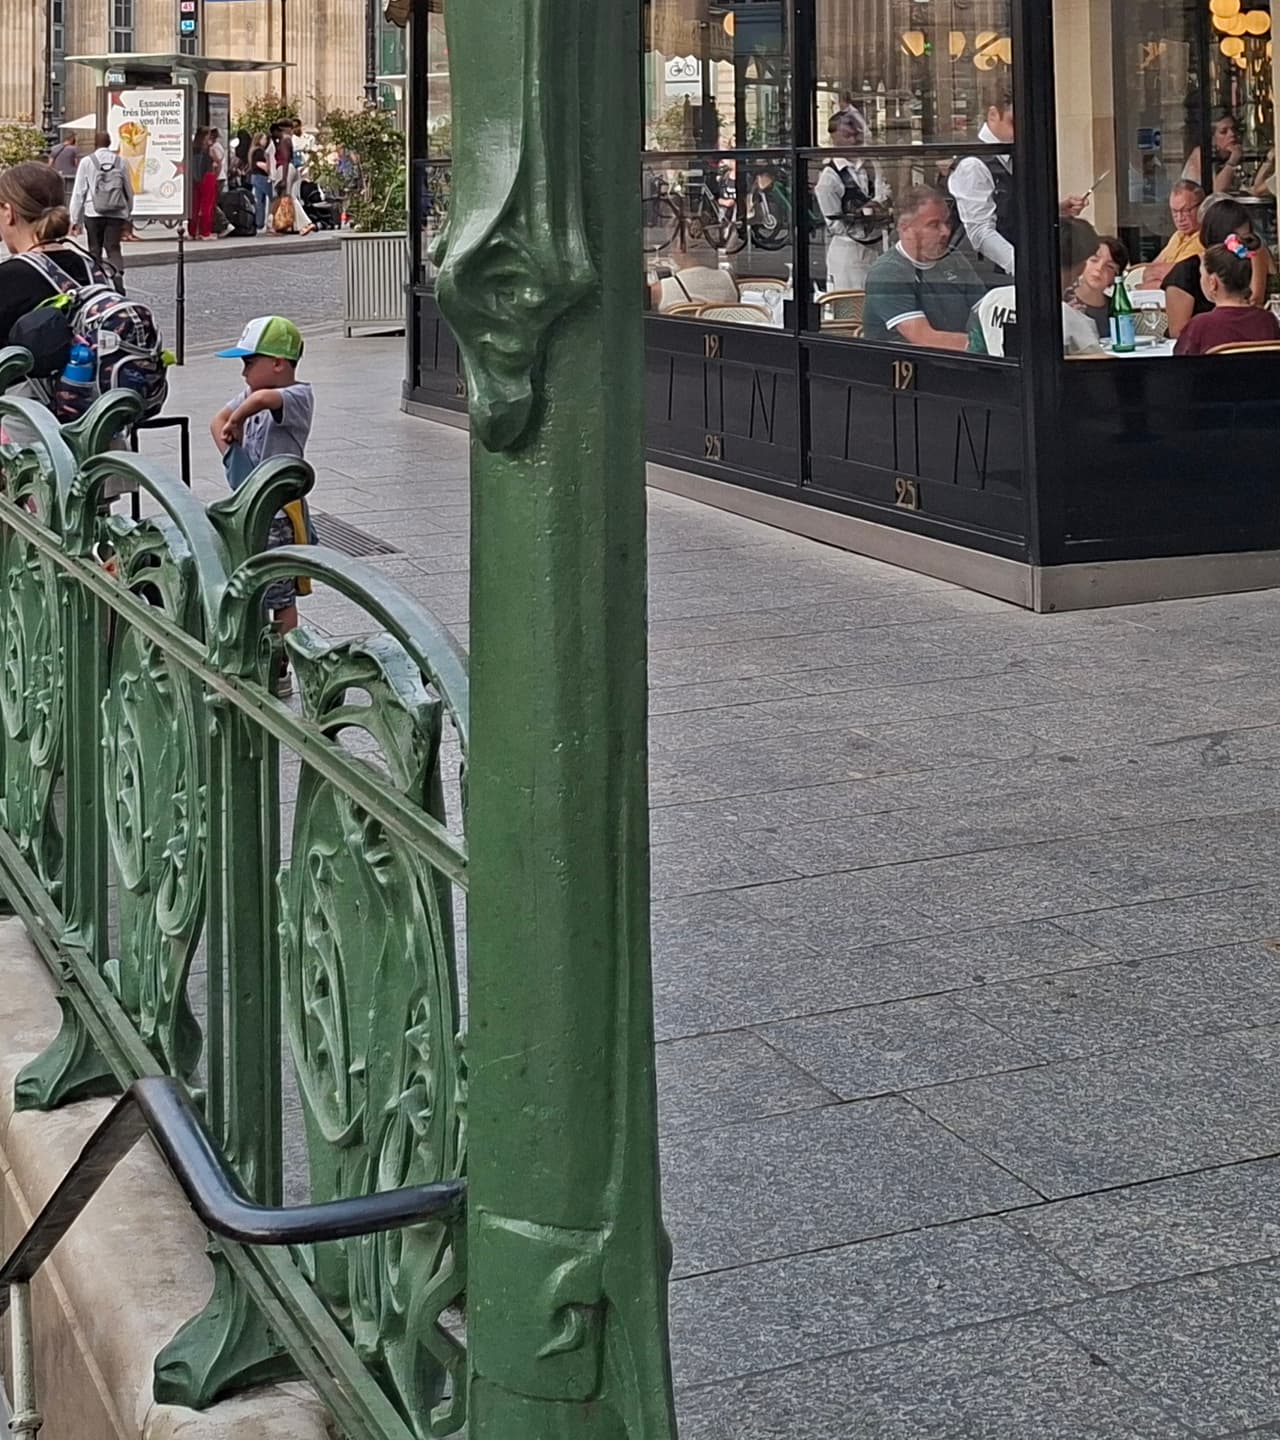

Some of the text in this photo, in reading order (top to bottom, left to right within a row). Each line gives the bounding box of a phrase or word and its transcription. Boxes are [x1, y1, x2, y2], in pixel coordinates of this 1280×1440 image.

[703, 334, 719, 358] 19
[891, 361, 913, 390] 19
[705, 434, 721, 460] 25
[895, 477, 916, 510] 25
